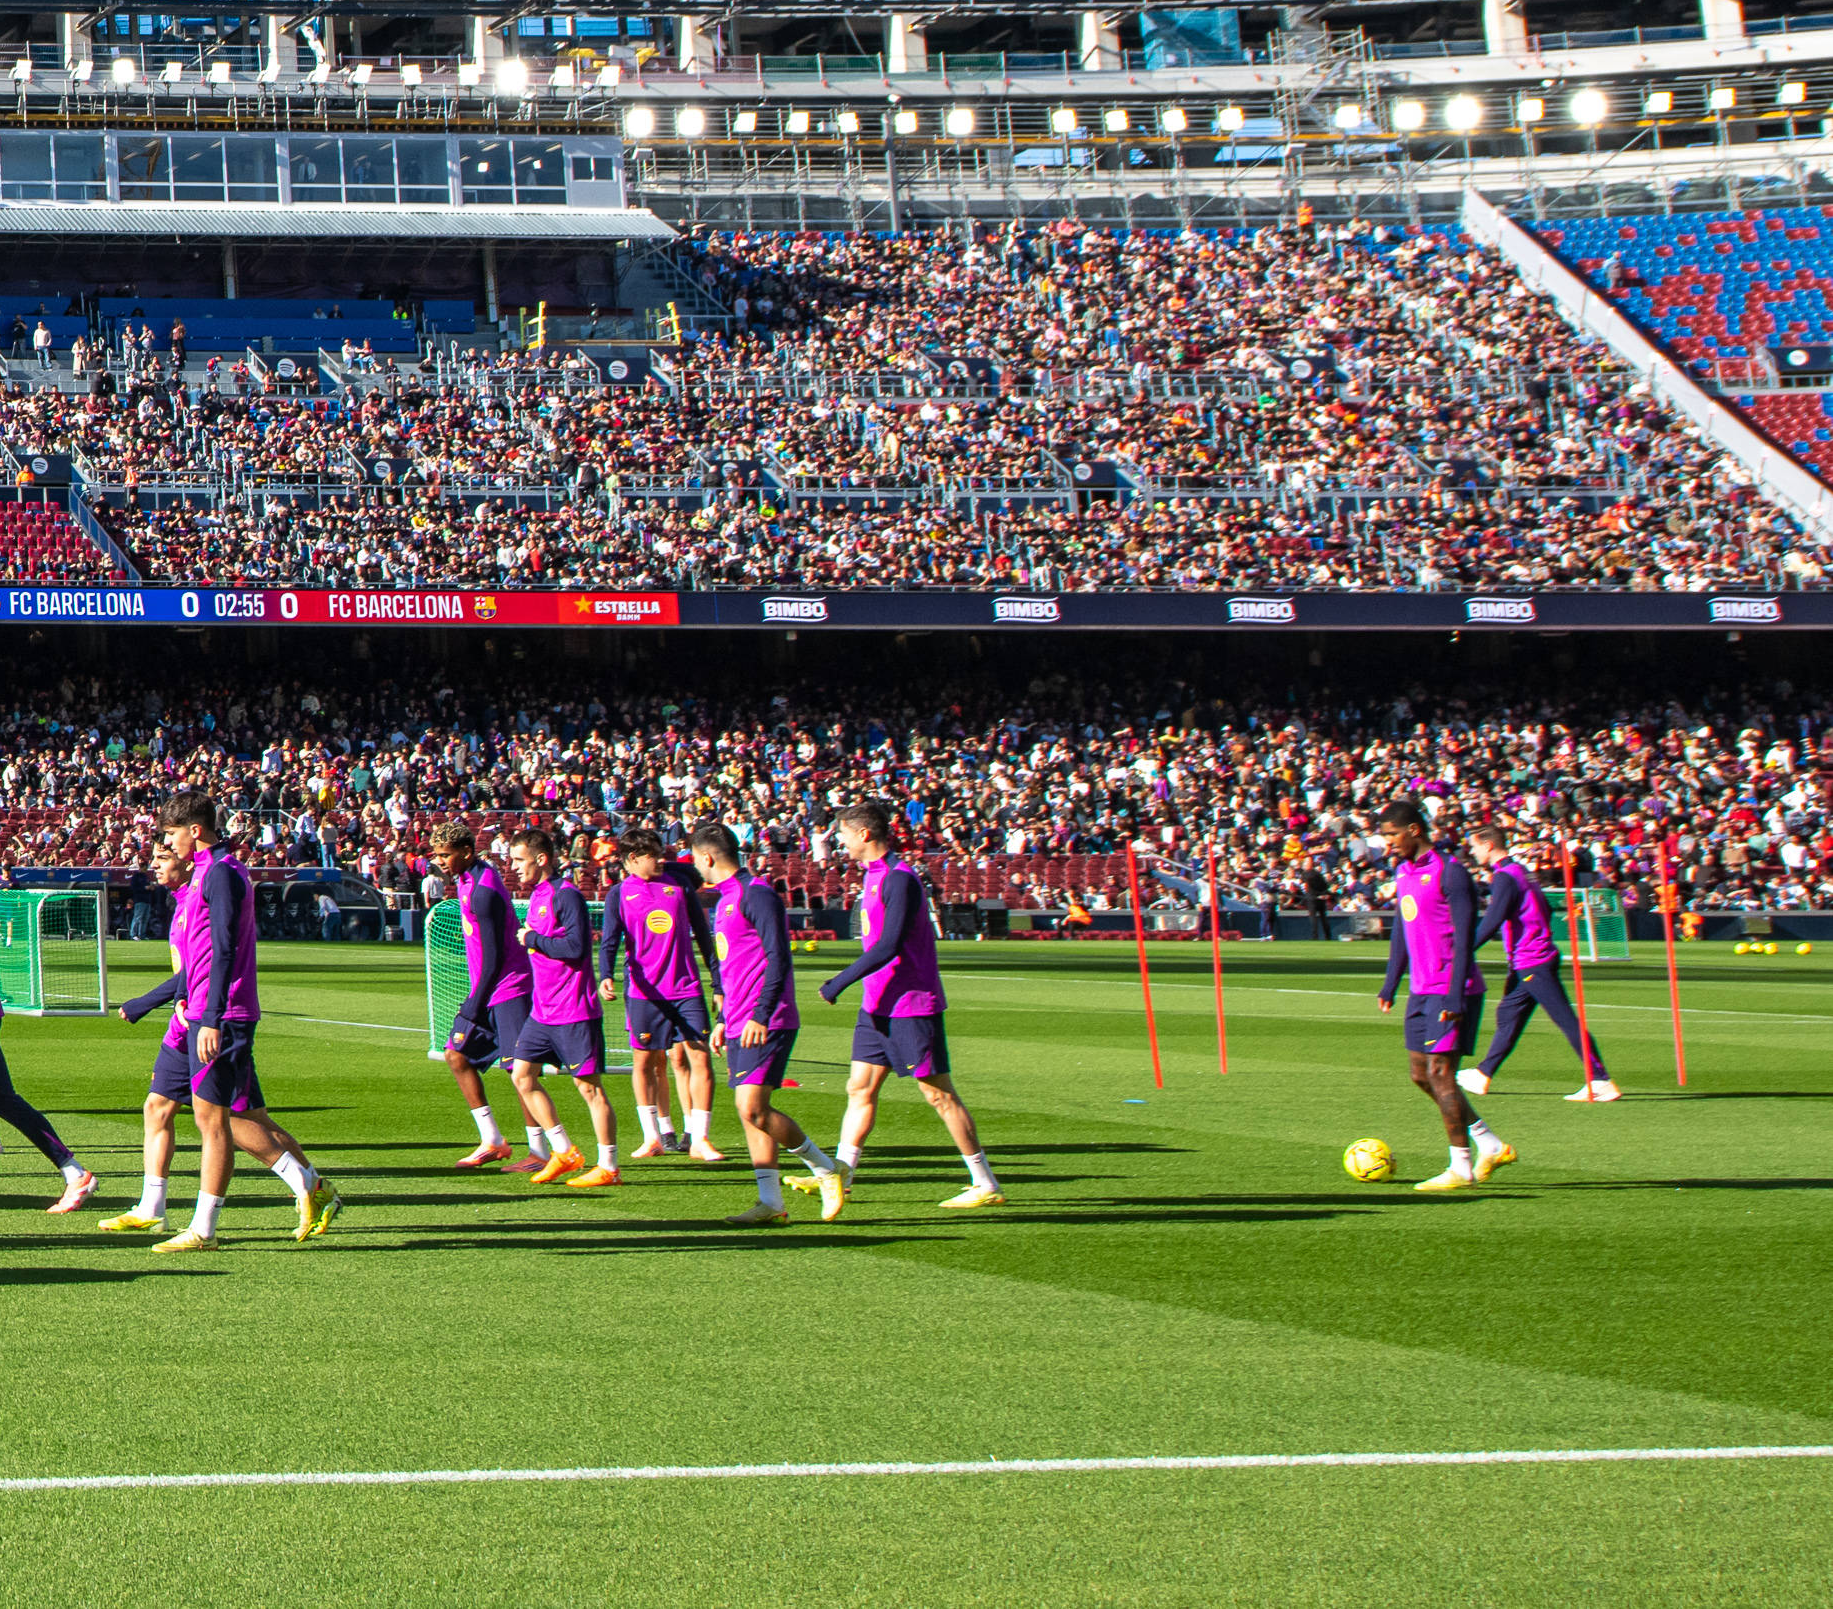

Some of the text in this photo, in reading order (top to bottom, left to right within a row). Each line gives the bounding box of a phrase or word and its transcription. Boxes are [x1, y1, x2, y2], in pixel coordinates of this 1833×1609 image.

[9, 591, 464, 619] FC BARCELONA 0 02:55 0 FC BARCELONA
[594, 601, 661, 614] ESTRELLA
[764, 601, 827, 617] BIMBO
[994, 601, 1060, 618] BIMBO
[1229, 601, 1295, 618] BIMBO
[1467, 602, 1535, 618] BIMBO
[1709, 602, 1781, 619] BIMBO
